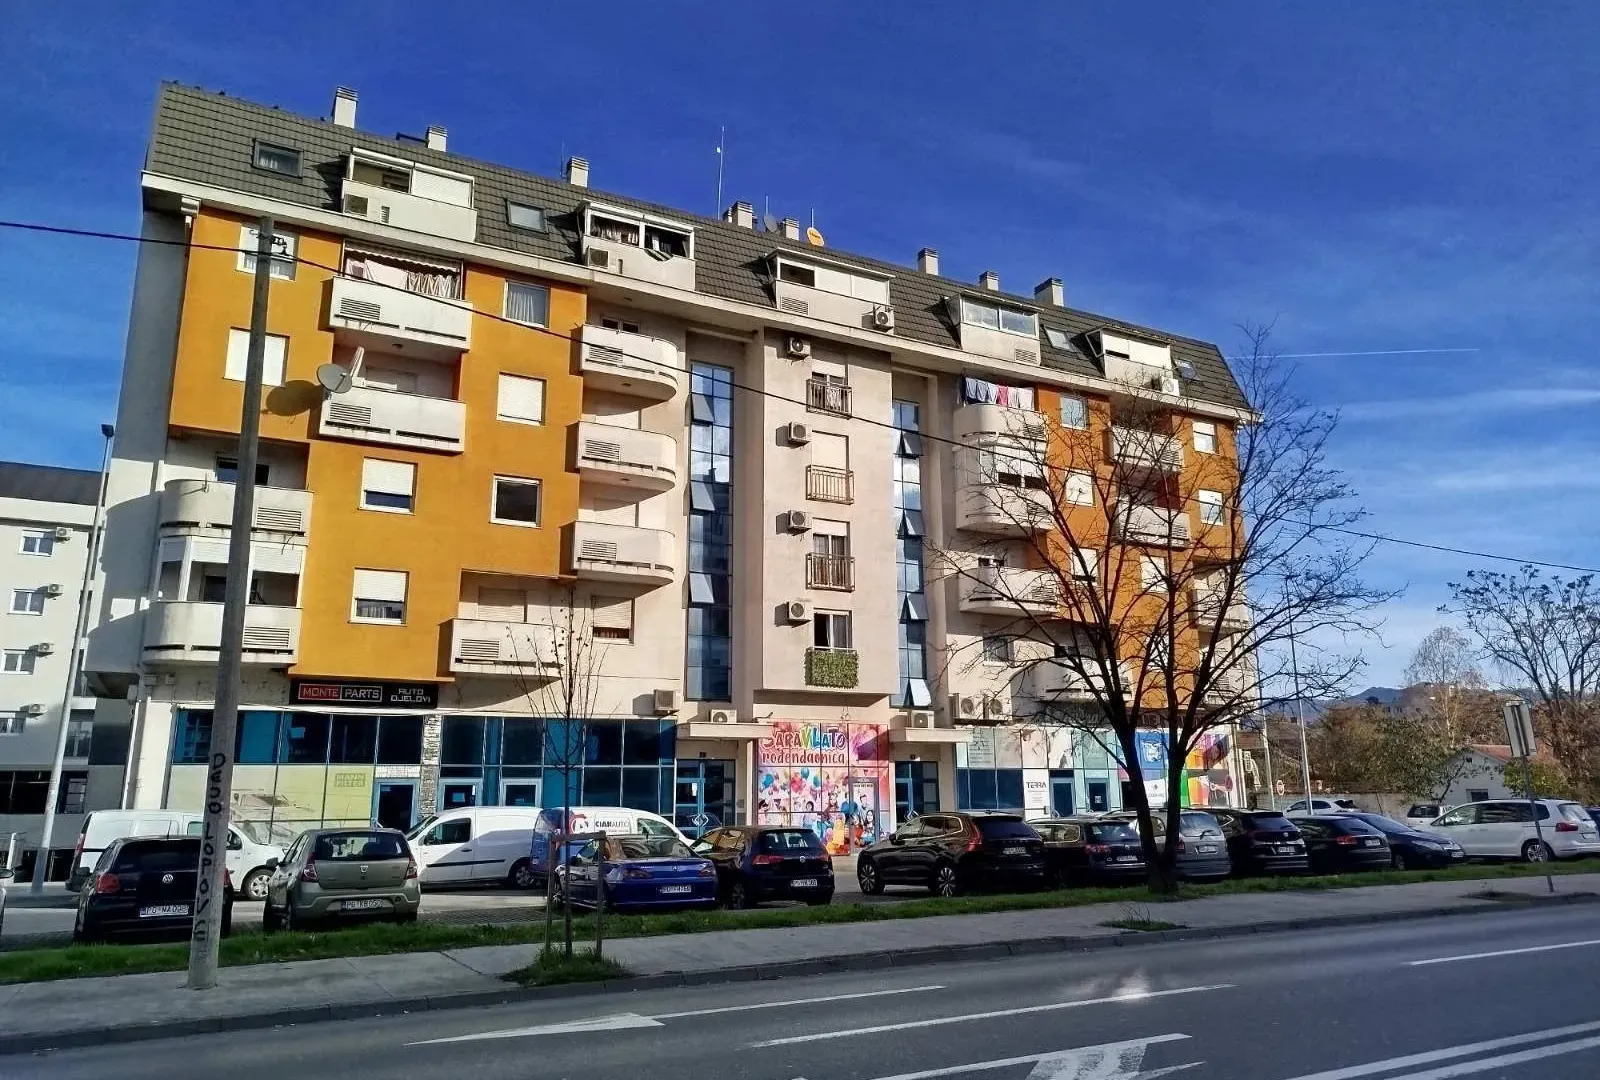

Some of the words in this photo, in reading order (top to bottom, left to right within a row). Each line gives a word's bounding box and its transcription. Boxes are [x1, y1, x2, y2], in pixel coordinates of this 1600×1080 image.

[302, 687, 339, 698] MONTE
[344, 688, 380, 699] PARTS
[398, 687, 424, 695] AUTO
